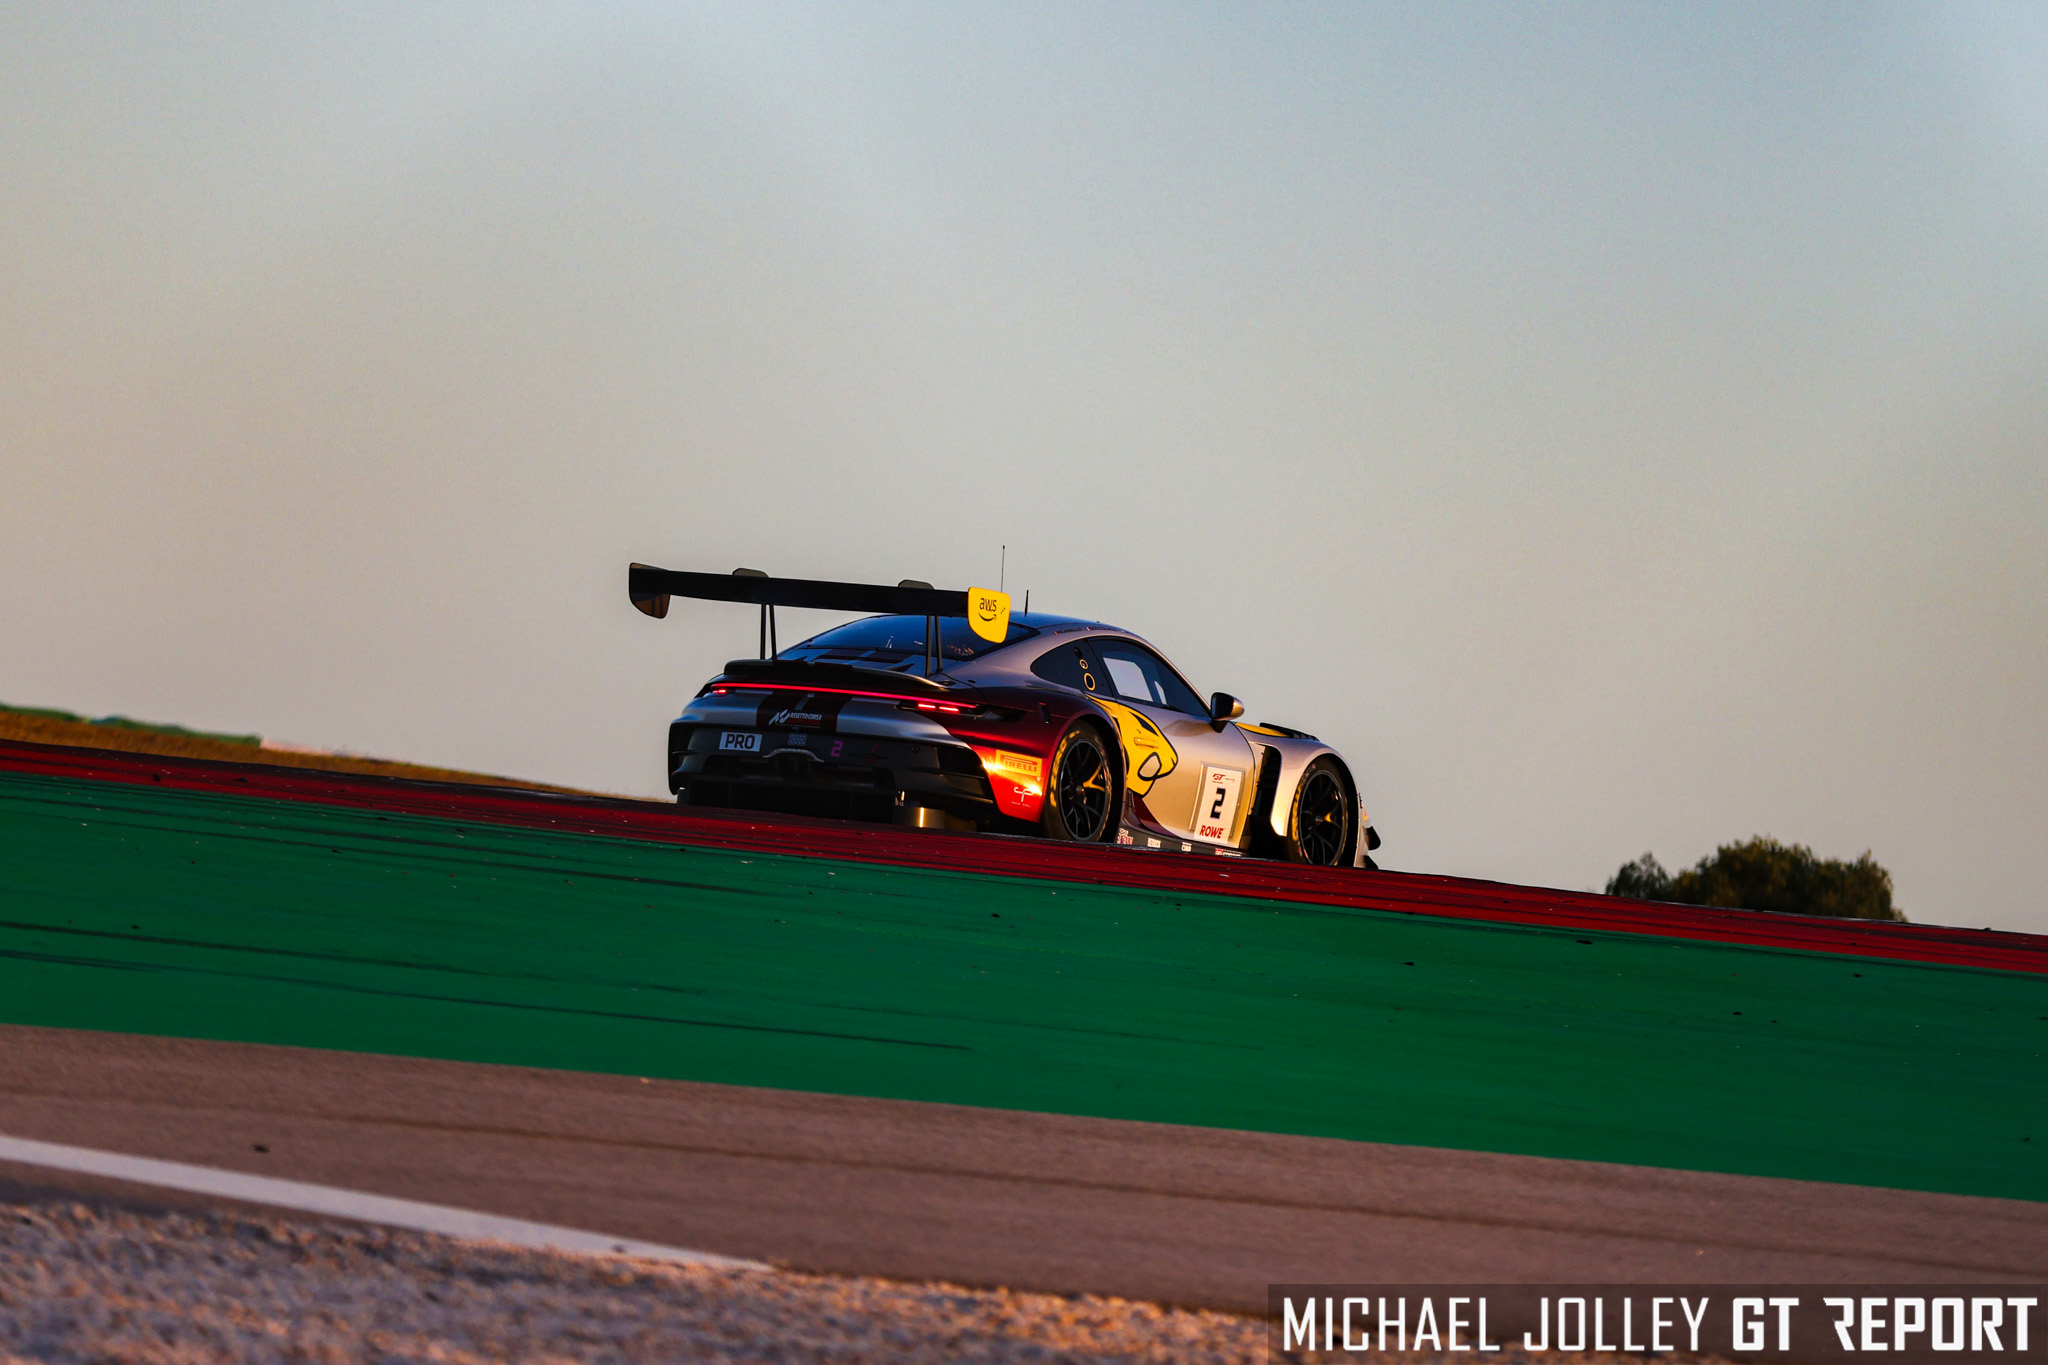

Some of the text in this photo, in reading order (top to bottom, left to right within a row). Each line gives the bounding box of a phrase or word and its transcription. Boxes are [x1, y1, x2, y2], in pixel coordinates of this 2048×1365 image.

[979, 598, 997, 612] aws
[725, 734, 755, 749] PRO
[831, 740, 844, 756] 2
[1210, 787, 1226, 819] 2
[1200, 825, 1225, 839] ROWE
